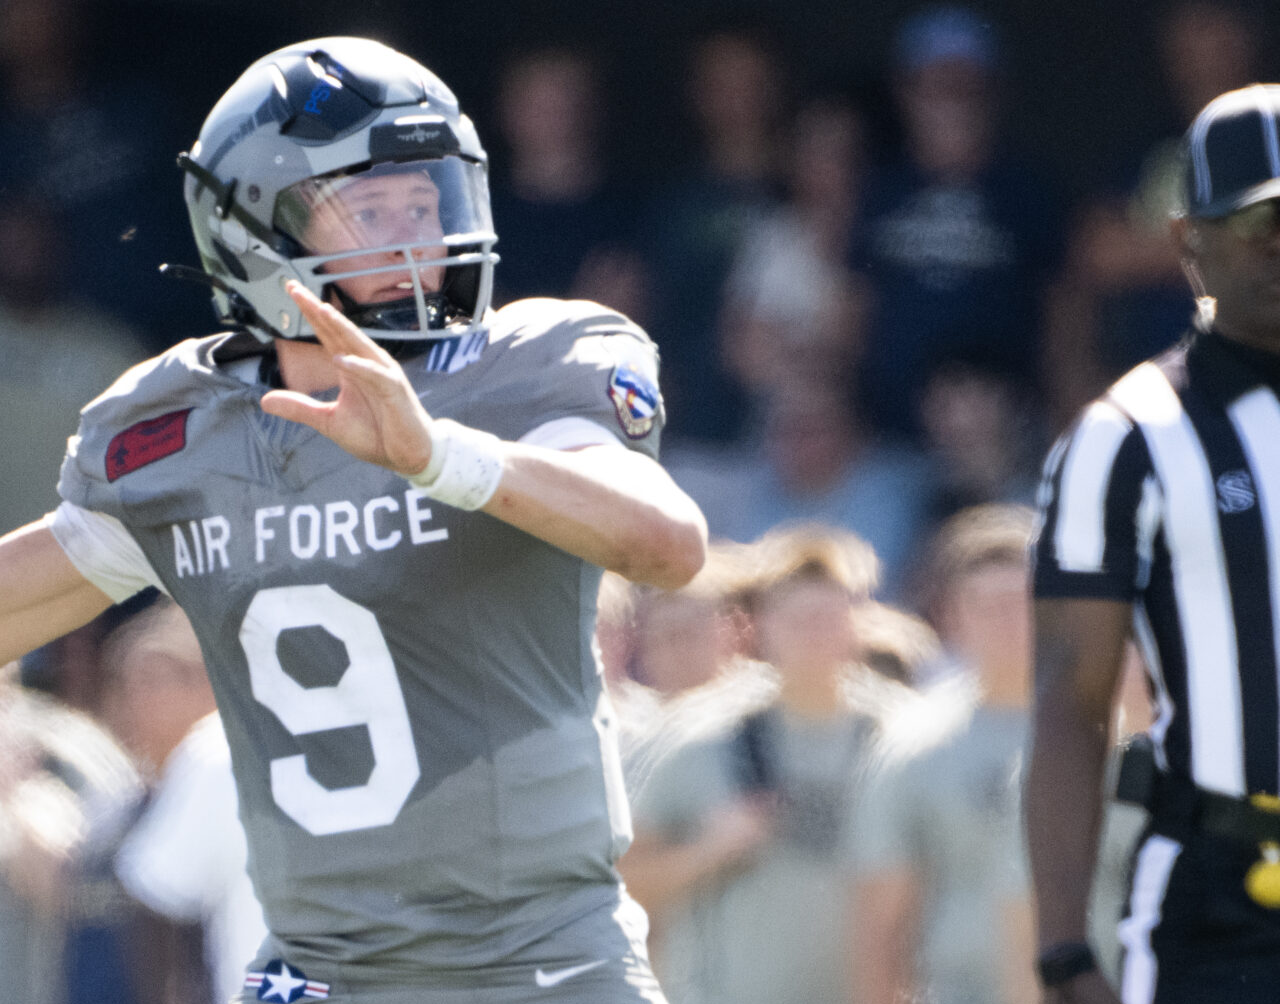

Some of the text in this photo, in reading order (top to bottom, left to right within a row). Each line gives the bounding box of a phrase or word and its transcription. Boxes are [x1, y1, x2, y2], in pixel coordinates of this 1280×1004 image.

[171, 489, 448, 578] AIR FORCE
[239, 583, 421, 836] 9
